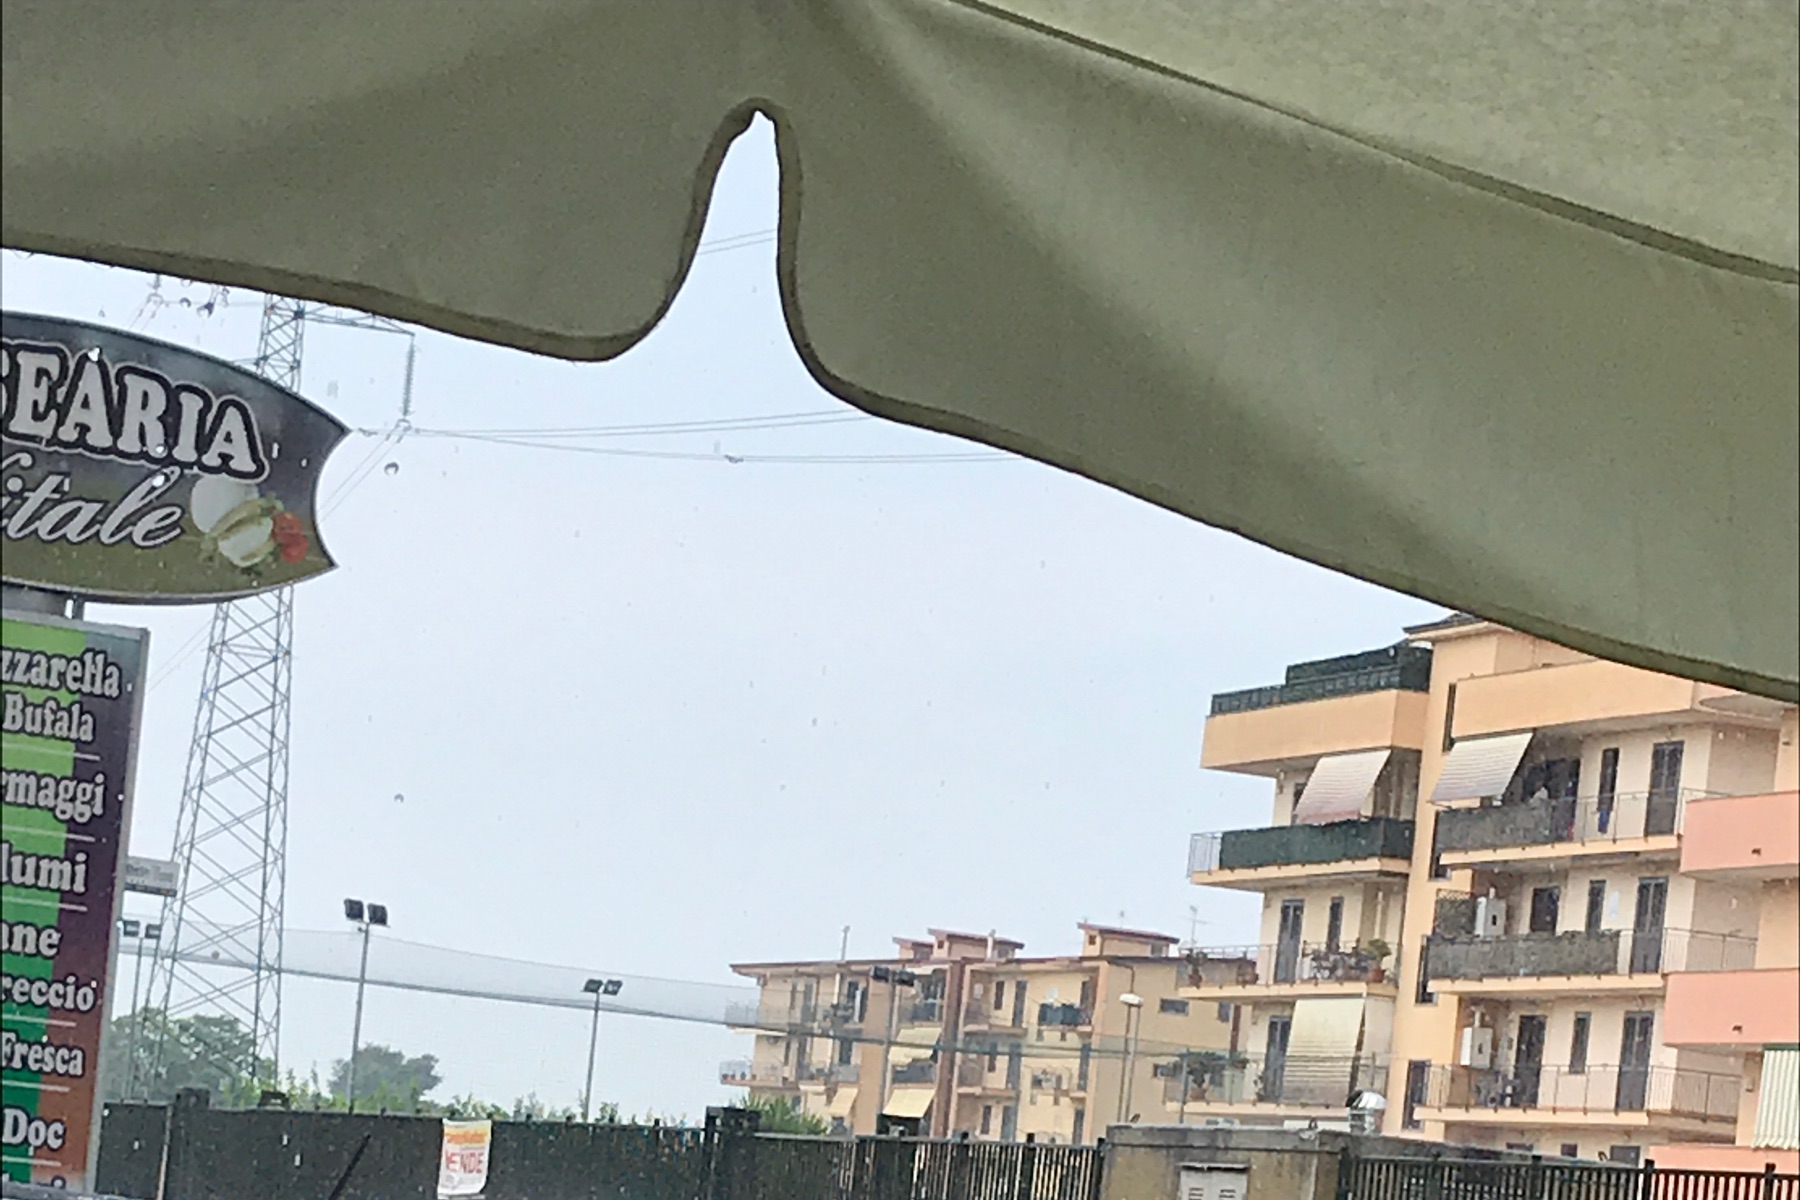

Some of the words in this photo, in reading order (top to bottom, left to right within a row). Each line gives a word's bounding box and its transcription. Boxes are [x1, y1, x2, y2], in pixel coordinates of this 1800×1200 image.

[2, 347, 258, 474] EARIA
[2, 453, 182, 547] itale
[2, 692, 94, 742] Bufala
[2, 1031, 83, 1076] Fresca
[2, 1108, 65, 1149] Doc
